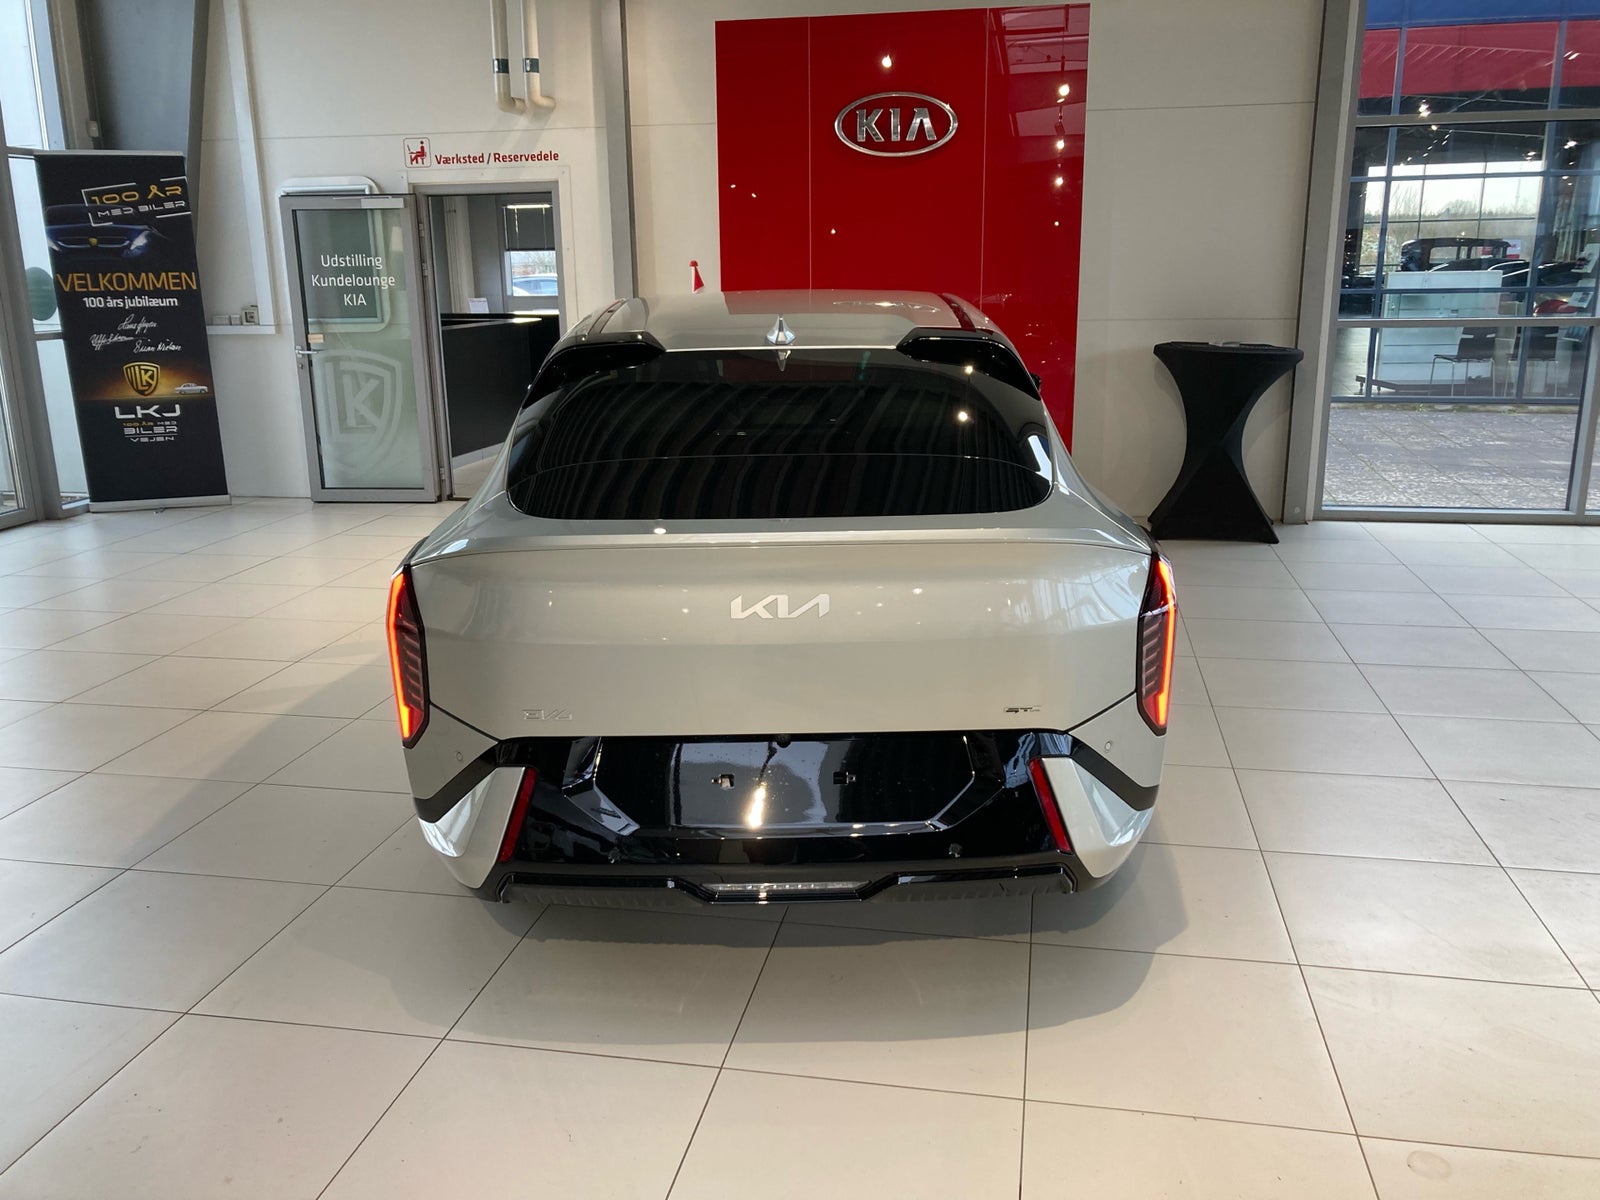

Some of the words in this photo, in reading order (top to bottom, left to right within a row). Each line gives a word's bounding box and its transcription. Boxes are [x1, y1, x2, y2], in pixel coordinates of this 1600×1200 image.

[856, 107, 937, 142] KIA
[435, 153, 484, 165] Værksted
[493, 150, 559, 163] Reservedele
[91, 191, 139, 205] 100
[97, 207, 133, 218] MED
[138, 200, 186, 212] BILER
[320, 254, 383, 270] Udstilling
[56, 271, 198, 292] VELKOMMEN
[311, 274, 396, 289] Kundelounge
[83, 297, 104, 308] 100
[106, 296, 124, 308] års
[124, 295, 178, 309] jubilæum
[343, 293, 367, 306] KIA
[114, 404, 180, 419] LKJ
[123, 426, 178, 435] BILER
[731, 593, 830, 619] KIA
